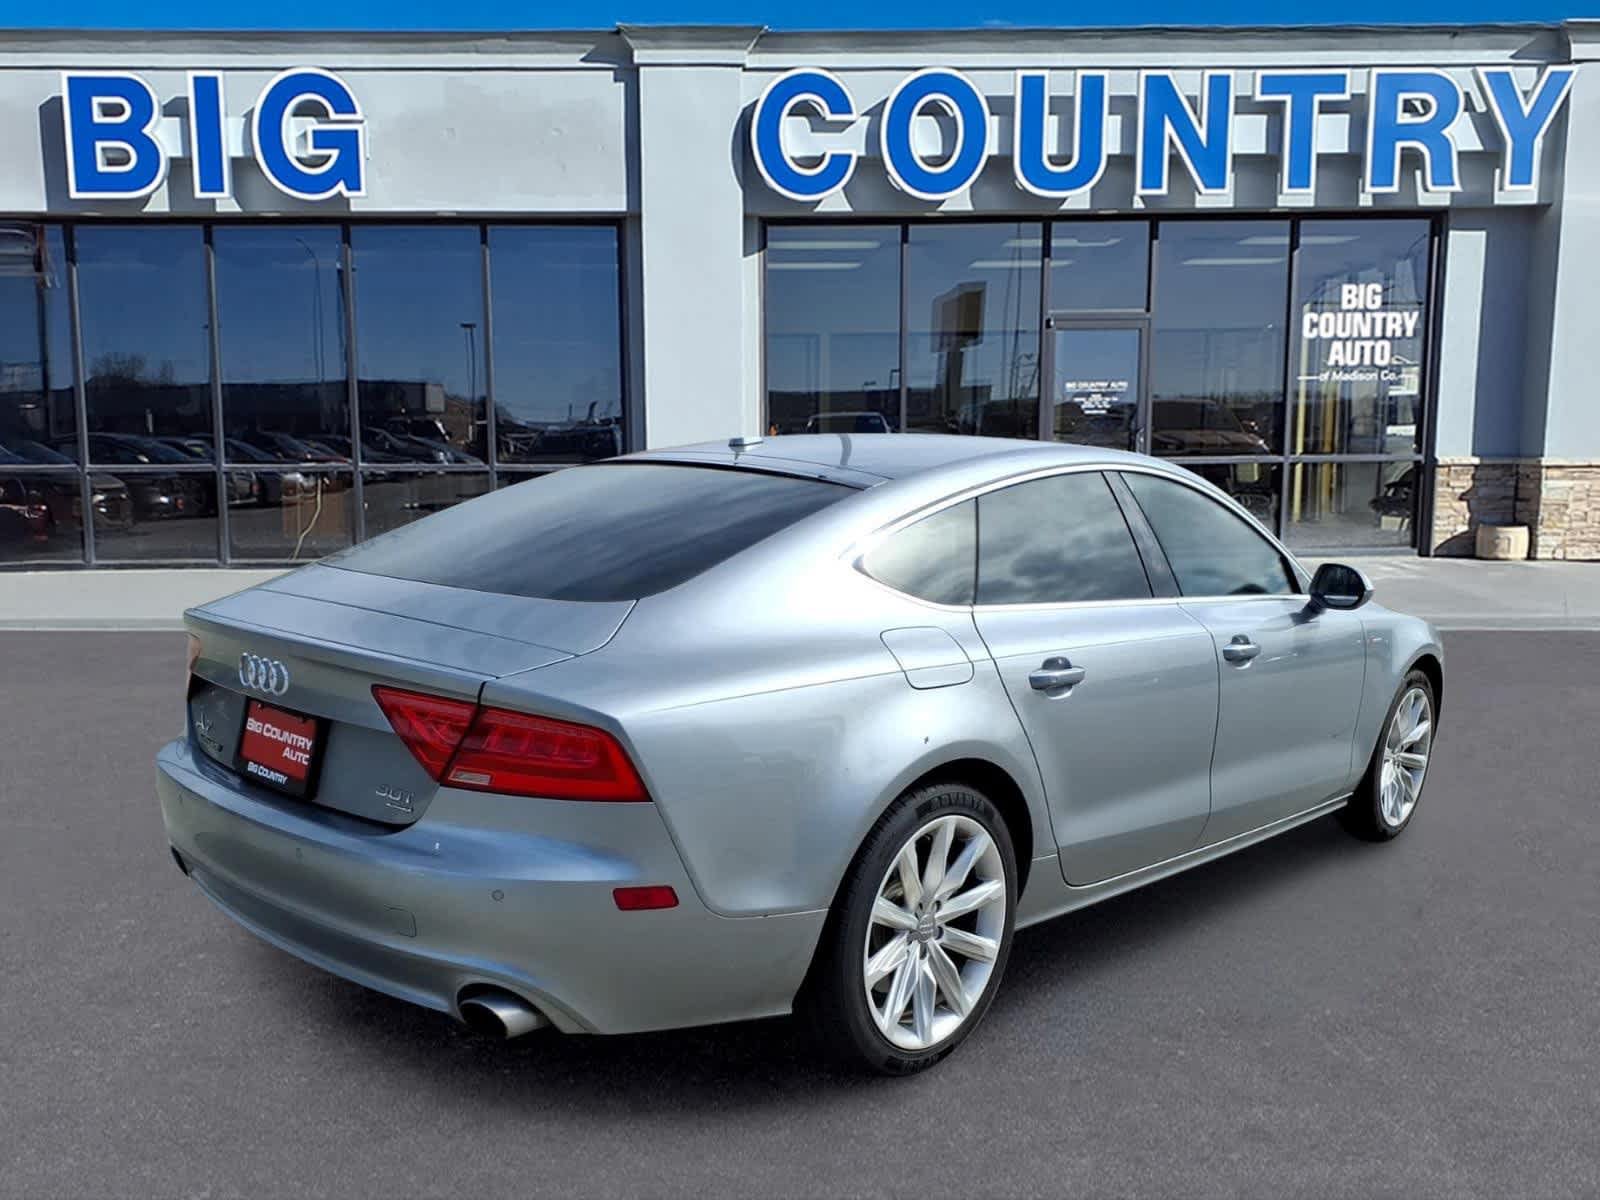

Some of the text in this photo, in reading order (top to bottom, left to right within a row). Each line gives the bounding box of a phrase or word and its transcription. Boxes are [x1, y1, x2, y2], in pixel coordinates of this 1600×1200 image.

[61, 66, 1576, 202] BIG COUNTRY
[1342, 284, 1382, 309] BIG
[1303, 312, 1419, 338] COUNTRY
[1327, 340, 1391, 366] AUTO
[1319, 370, 1330, 381] of
[1331, 370, 1379, 381] Madison
[246, 717, 313, 751] BIG COUNTRY
[247, 761, 288, 784] BIG COUNTRY
